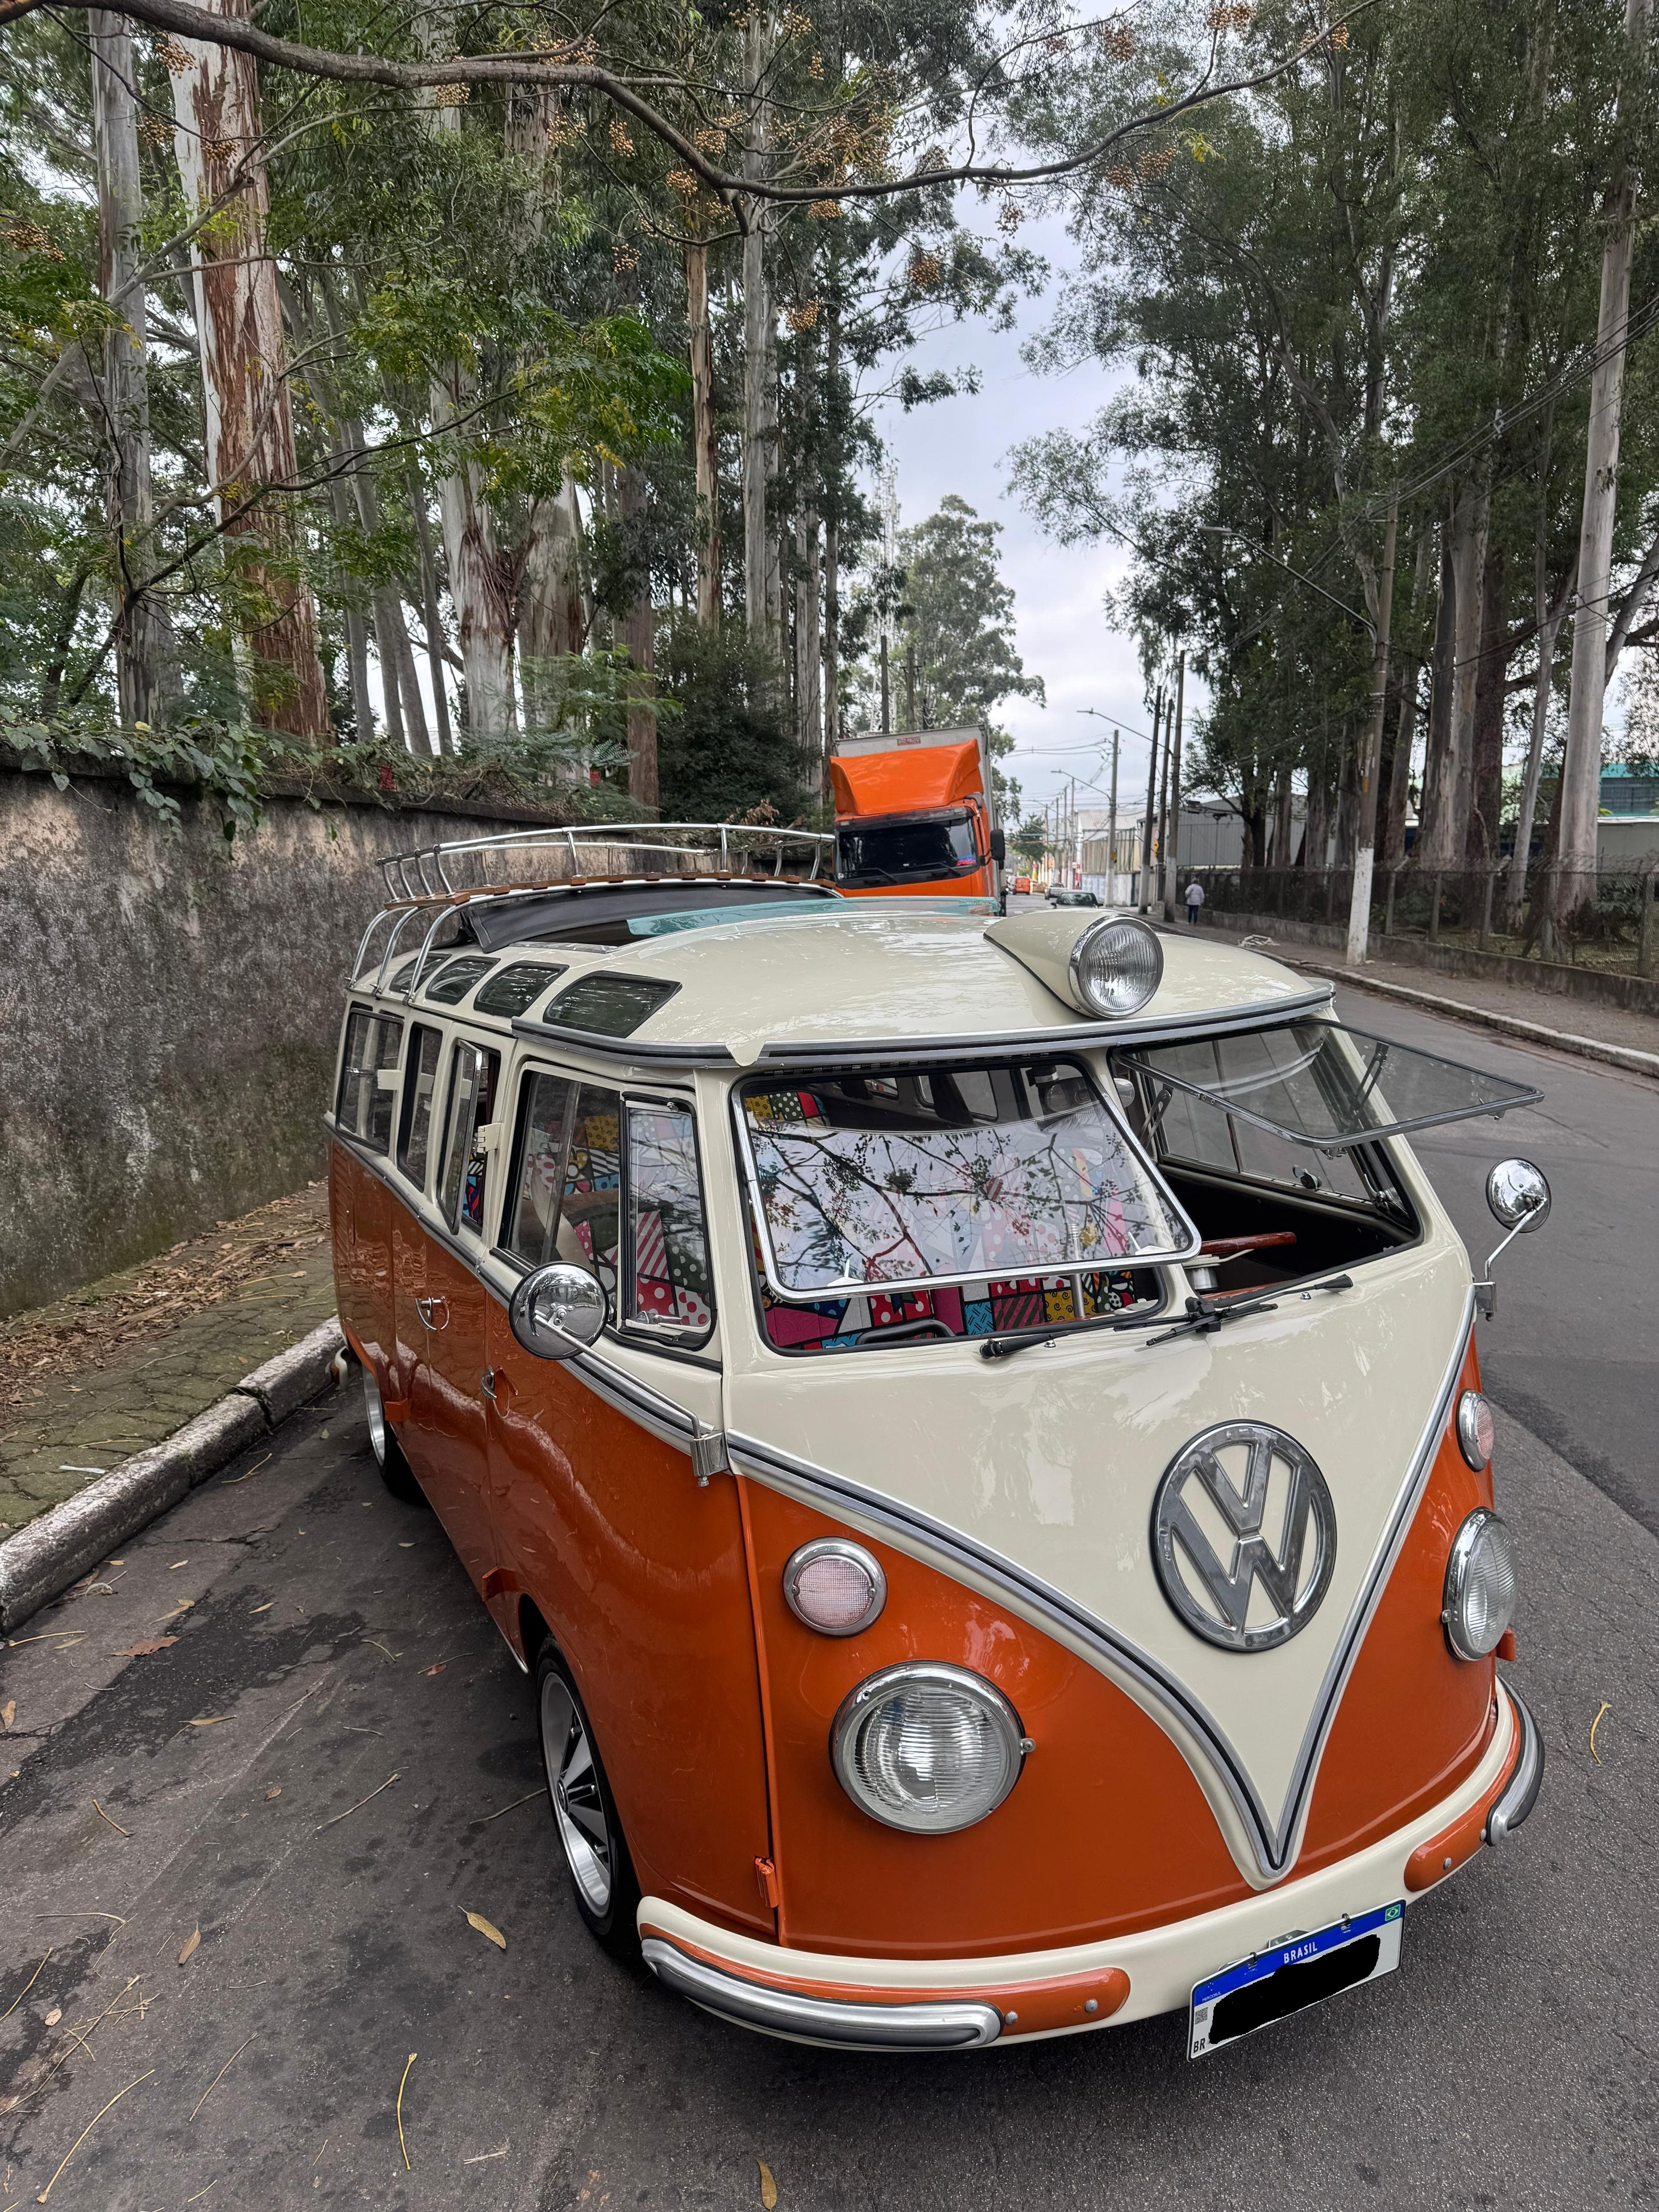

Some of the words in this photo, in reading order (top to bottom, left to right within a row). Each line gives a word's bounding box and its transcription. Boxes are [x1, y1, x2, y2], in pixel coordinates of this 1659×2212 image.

[1155, 1424, 1335, 1648] VW
[1284, 1941, 1318, 1964] BRASIL
[1202, 1991, 1221, 2002] MERCOSUL
[1193, 2038, 1205, 2054] BR
